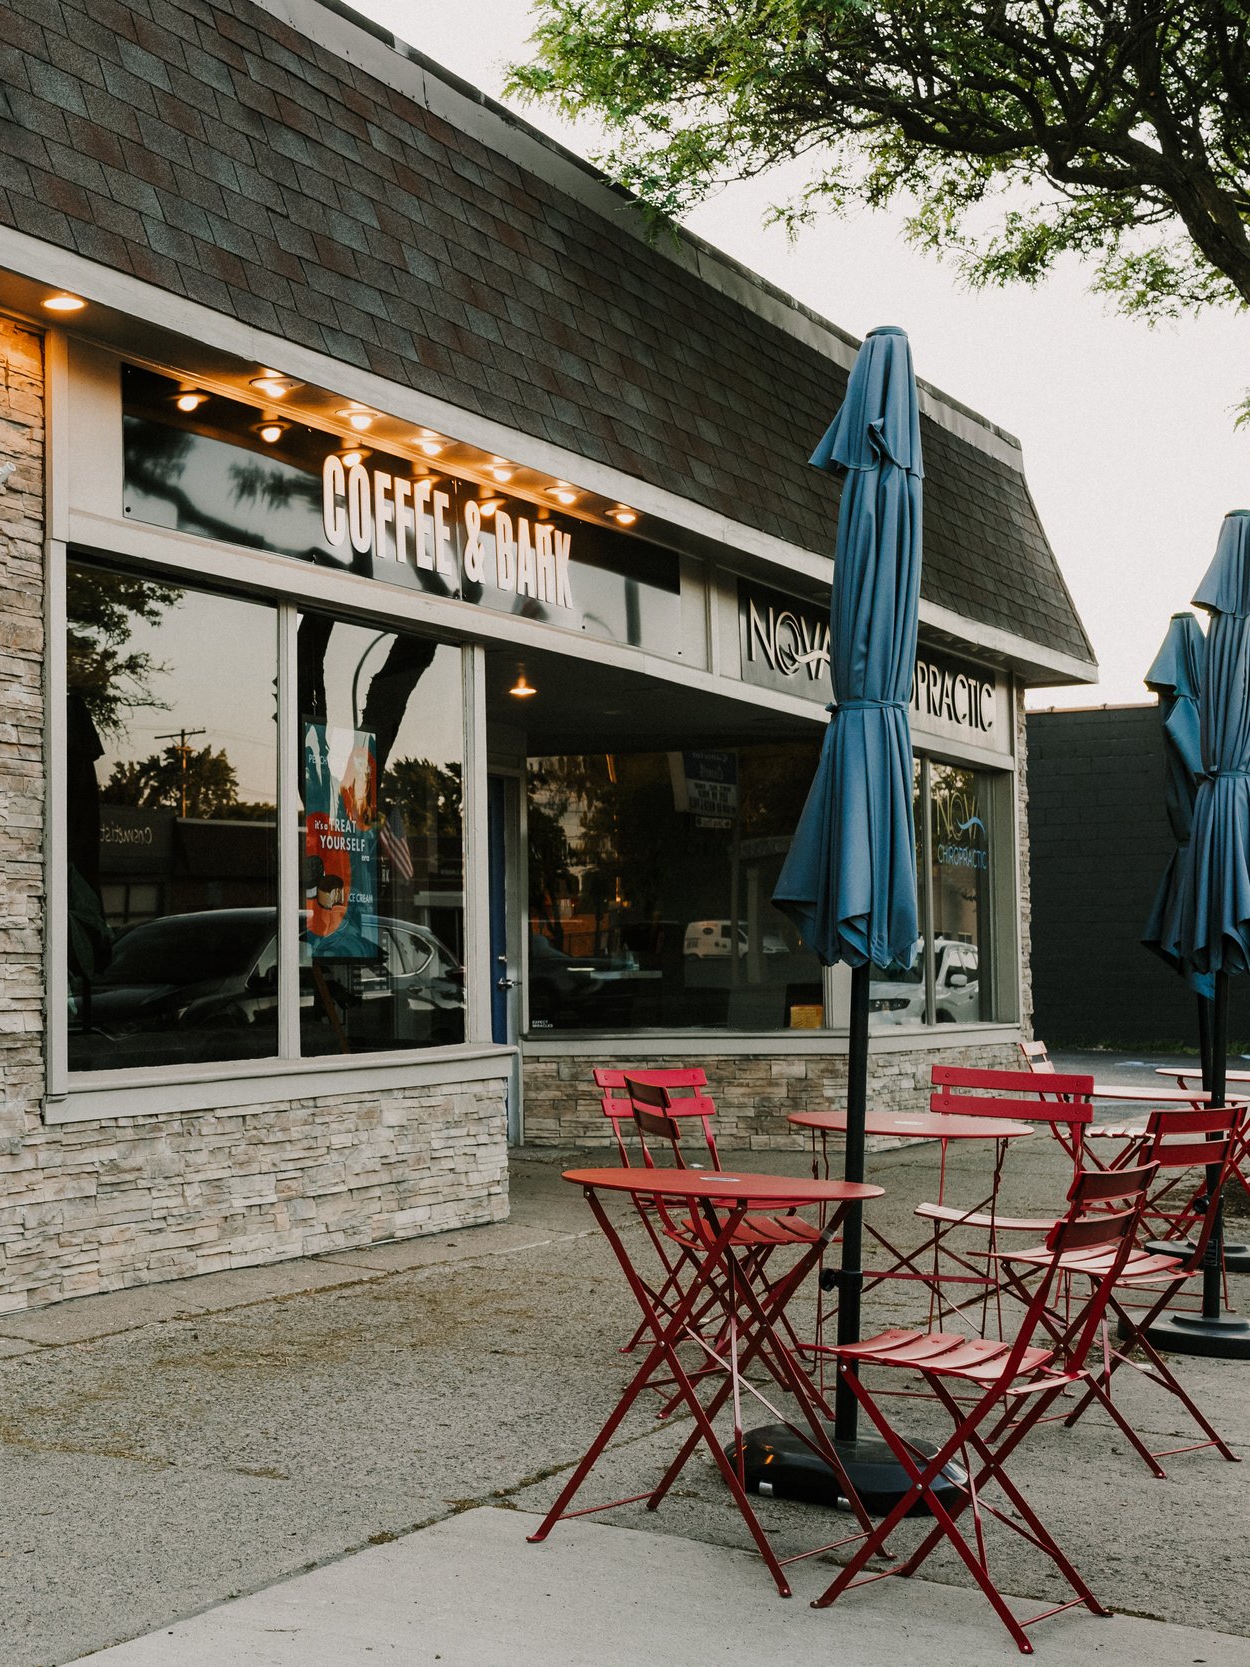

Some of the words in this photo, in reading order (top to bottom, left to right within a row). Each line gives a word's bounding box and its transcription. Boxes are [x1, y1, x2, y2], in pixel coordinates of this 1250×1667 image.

[322, 454, 453, 576] COFFEE
[463, 500, 486, 585] &
[494, 509, 573, 609] BARK
[912, 660, 994, 732] PRACTIC
[329, 818, 357, 833] TREAT
[935, 788, 987, 841] NOVA
[319, 834, 366, 852] YOURSELF
[937, 843, 987, 870] CHIROPRACTIC
[356, 893, 374, 904] CREAM
